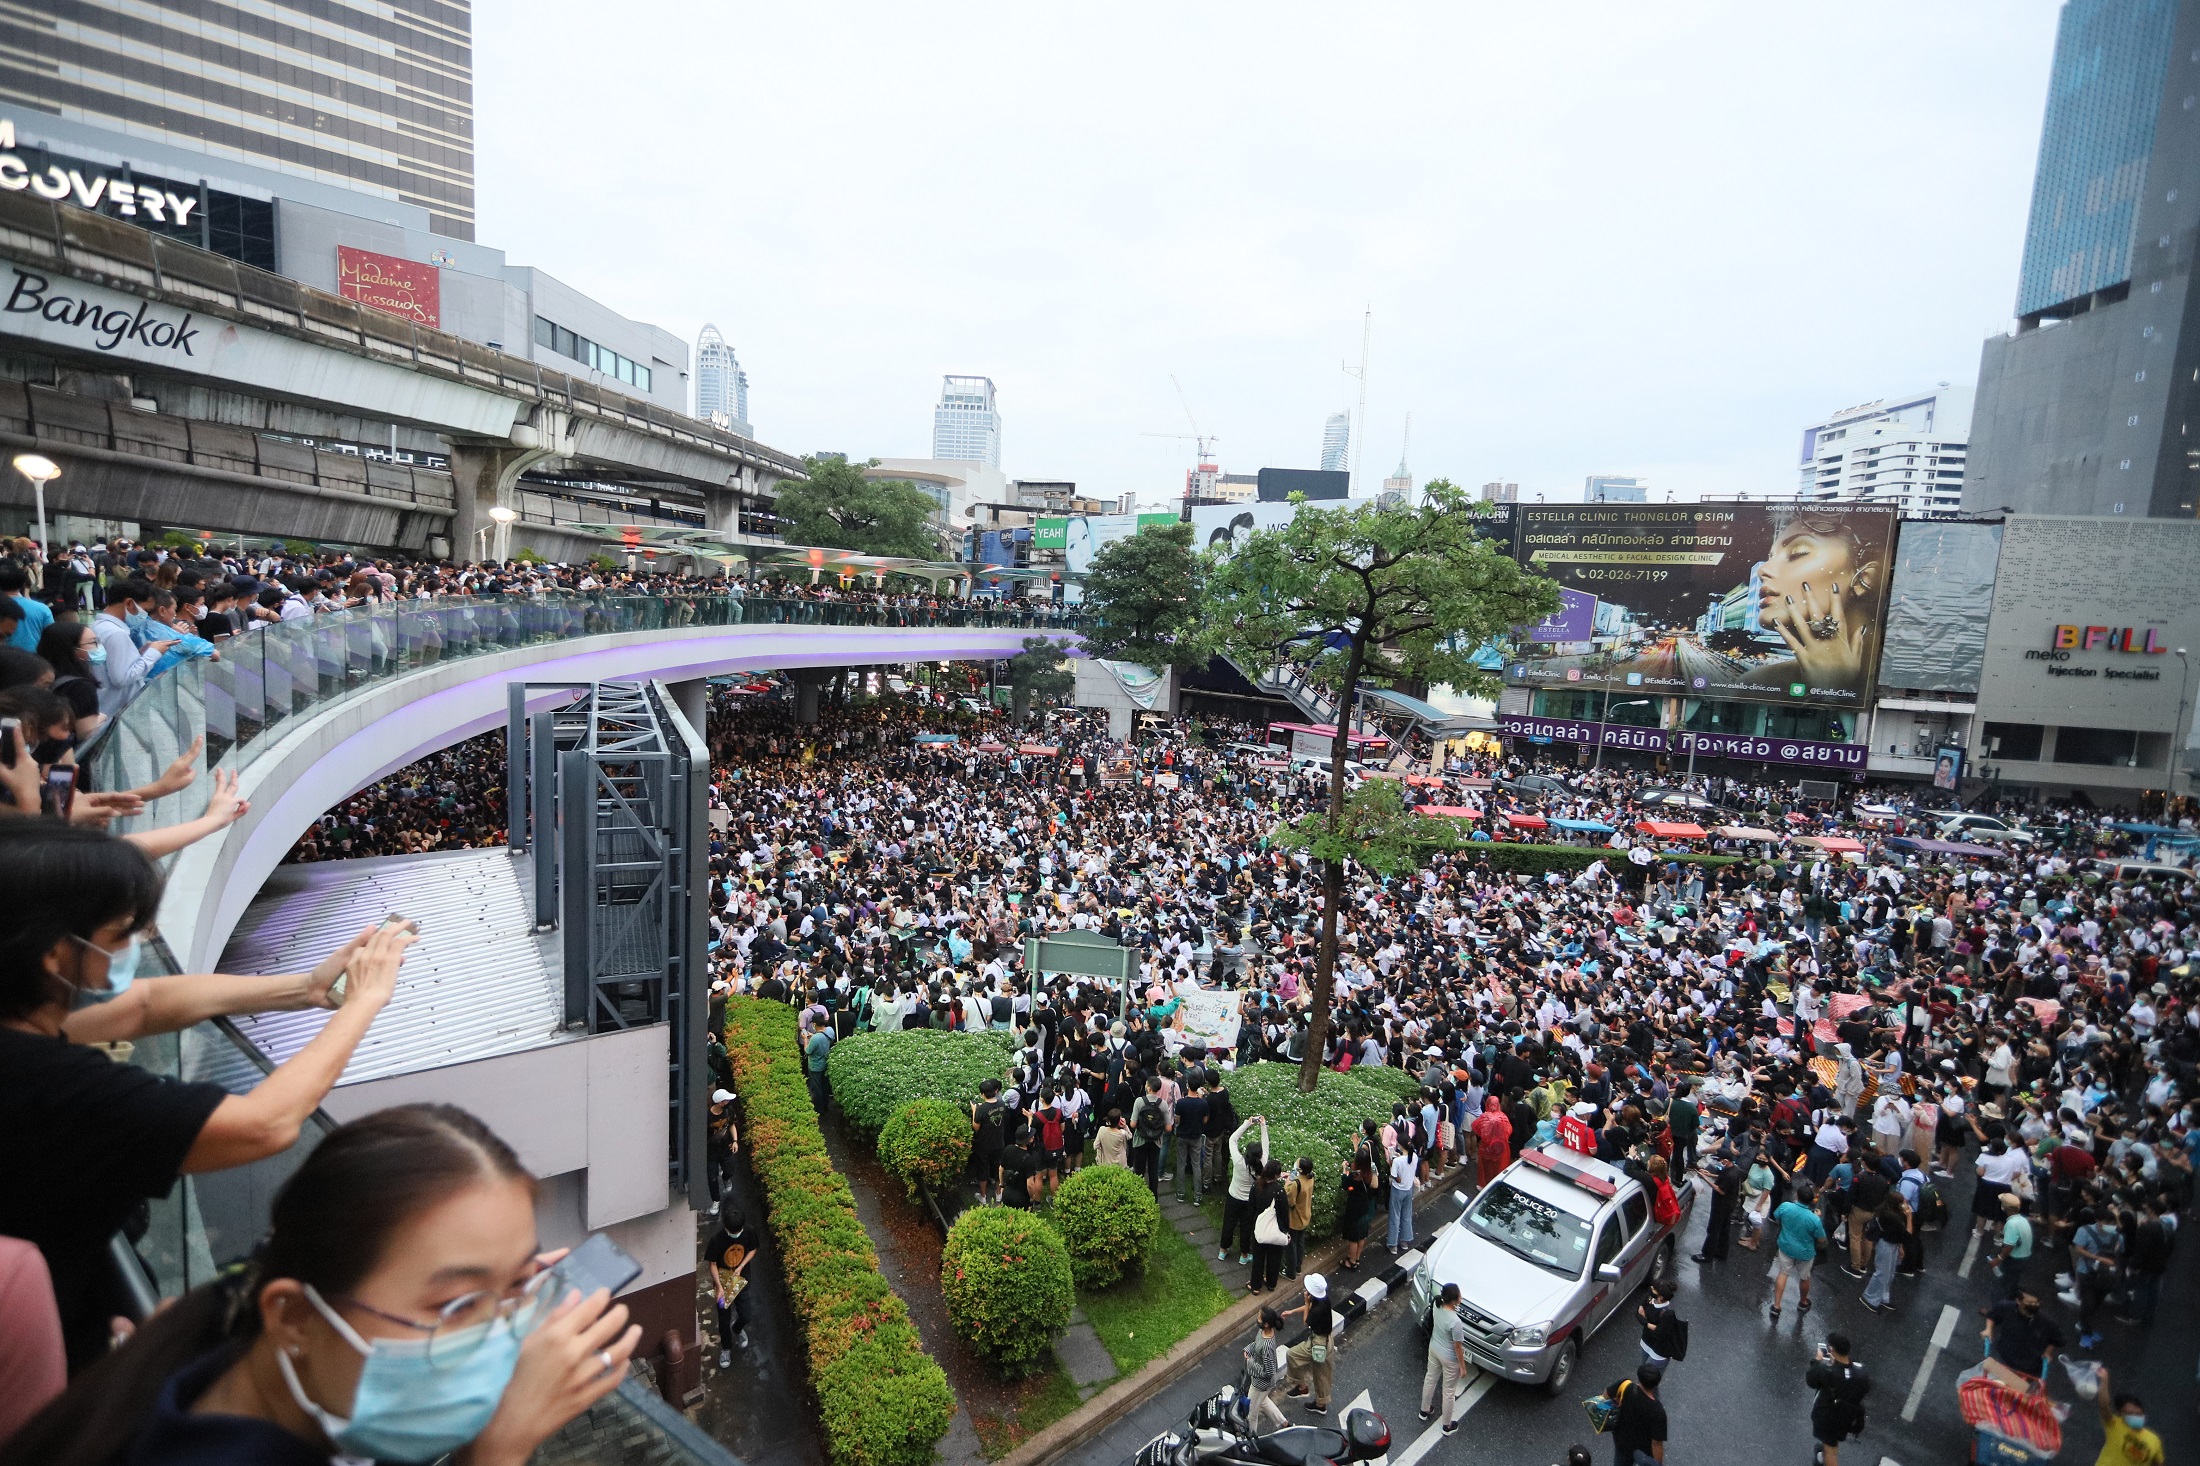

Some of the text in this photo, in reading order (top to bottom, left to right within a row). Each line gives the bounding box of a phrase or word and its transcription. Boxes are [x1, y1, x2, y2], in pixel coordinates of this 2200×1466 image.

[341, 258, 416, 290] Madame
[343, 282, 427, 321] Tussauds
[4, 267, 200, 356] Bangkok
[1528, 511, 1735, 523] ESTELLA CLINIC THONGLOR @SIAM
[1038, 528, 1064, 539] YEAH!
[1525, 532, 1732, 547] เอสเตลล่า คลินิกทองหล่อ สาขาสยาม
[1538, 552, 1570, 560] MEDICAL
[1573, 552, 1615, 561] AESTHETIC
[1626, 553, 1652, 562] FACIAL
[1656, 554, 1686, 562] DESIGN
[1588, 569, 1668, 582] 02-026-7199
[2025, 647, 2070, 661] meko
[1527, 669, 1561, 679] EstellaClinic
[2047, 665, 2160, 681] Injection Specialist
[1643, 677, 1686, 687] @EstellaClinic
[1710, 681, 1781, 693] www.estella-clinic.com
[1809, 687, 1857, 699] @EstellaClinic
[1503, 720, 1661, 749] เอสเตลล่า คลินิก
[1780, 743, 1862, 764] @สยาม
[1564, 1127, 1580, 1150] 44
[1513, 1193, 1558, 1219] POLICE 20
